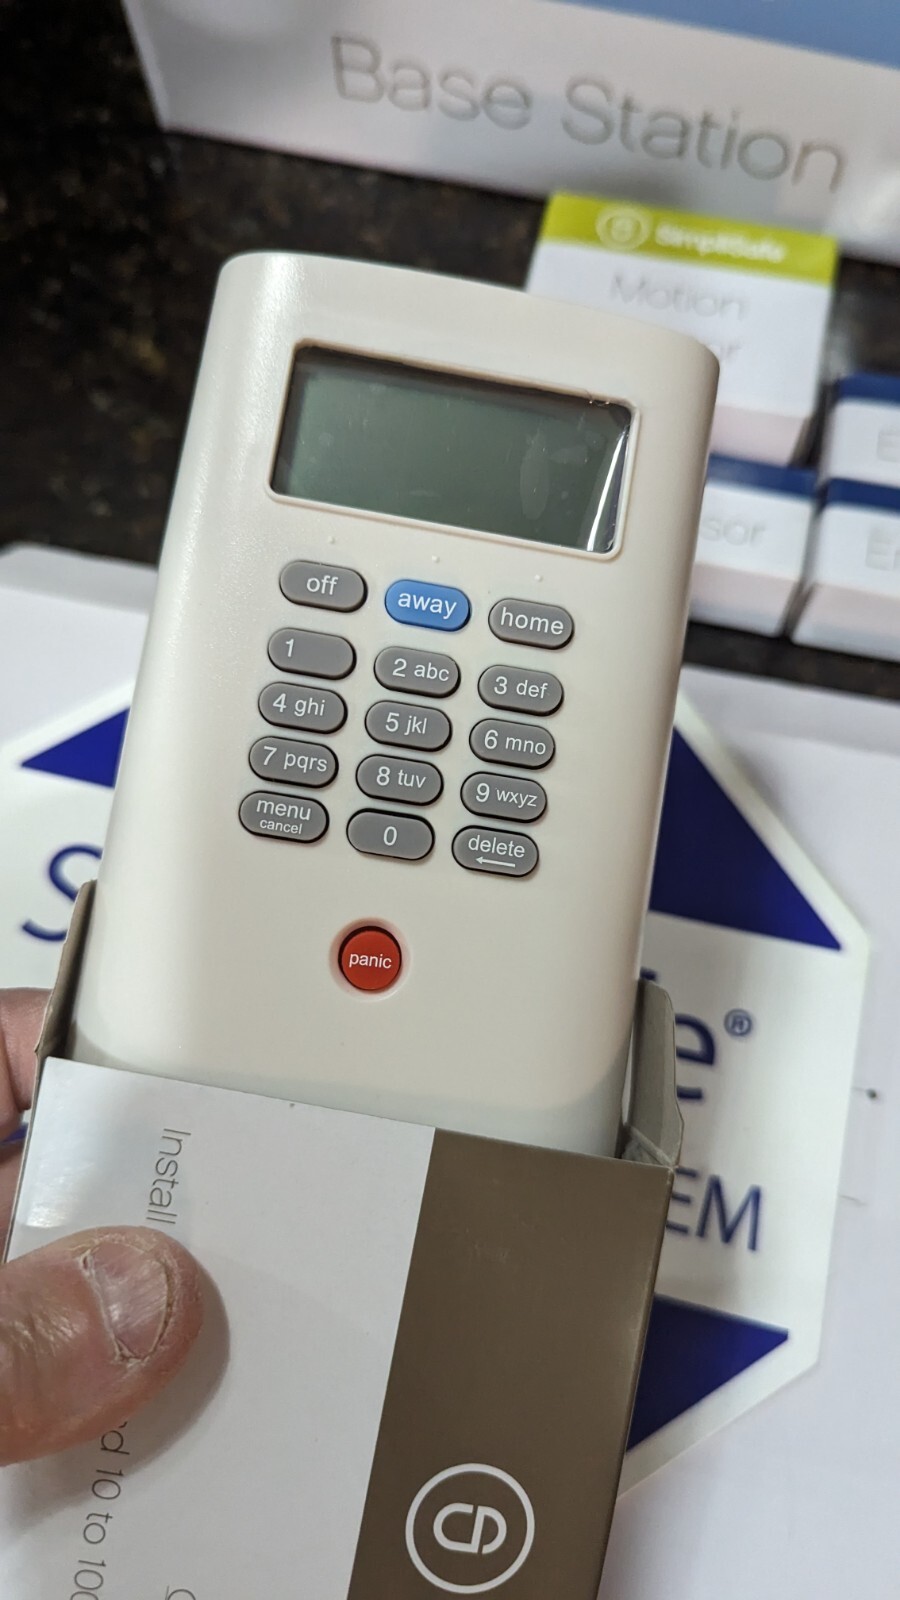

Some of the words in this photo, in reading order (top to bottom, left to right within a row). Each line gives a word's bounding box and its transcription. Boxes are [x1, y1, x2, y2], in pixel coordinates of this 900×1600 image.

[330, 35, 533, 130] Base
[560, 75, 847, 193] Station
[610, 270, 747, 320] Motion
[306, 574, 339, 596] off
[397, 591, 457, 619] away
[500, 606, 565, 636] home
[285, 638, 295, 658] 1
[392, 657, 407, 678] 2
[413, 662, 450, 682] abc
[493, 675, 508, 696] 3
[516, 679, 549, 699] def
[272, 693, 287, 713] 4
[294, 697, 326, 718] ghi
[385, 711, 400, 732] 5
[404, 715, 428, 736] jkl
[484, 729, 499, 750] 6
[505, 736, 547, 755] mno
[263, 746, 278, 766] 7
[283, 751, 329, 774] pqrs
[376, 765, 391, 786] 8
[397, 769, 427, 789] tuv
[475, 782, 490, 803] 9
[496, 788, 538, 809] wxyz
[256, 799, 312, 821] menu
[259, 818, 303, 835] cancel
[383, 826, 398, 846] 0
[468, 834, 526, 858] delete
[348, 952, 393, 969] panic
[146, 1128, 192, 1225] Install
[91, 1469, 124, 1501] 10
[83, 1512, 114, 1545] to
